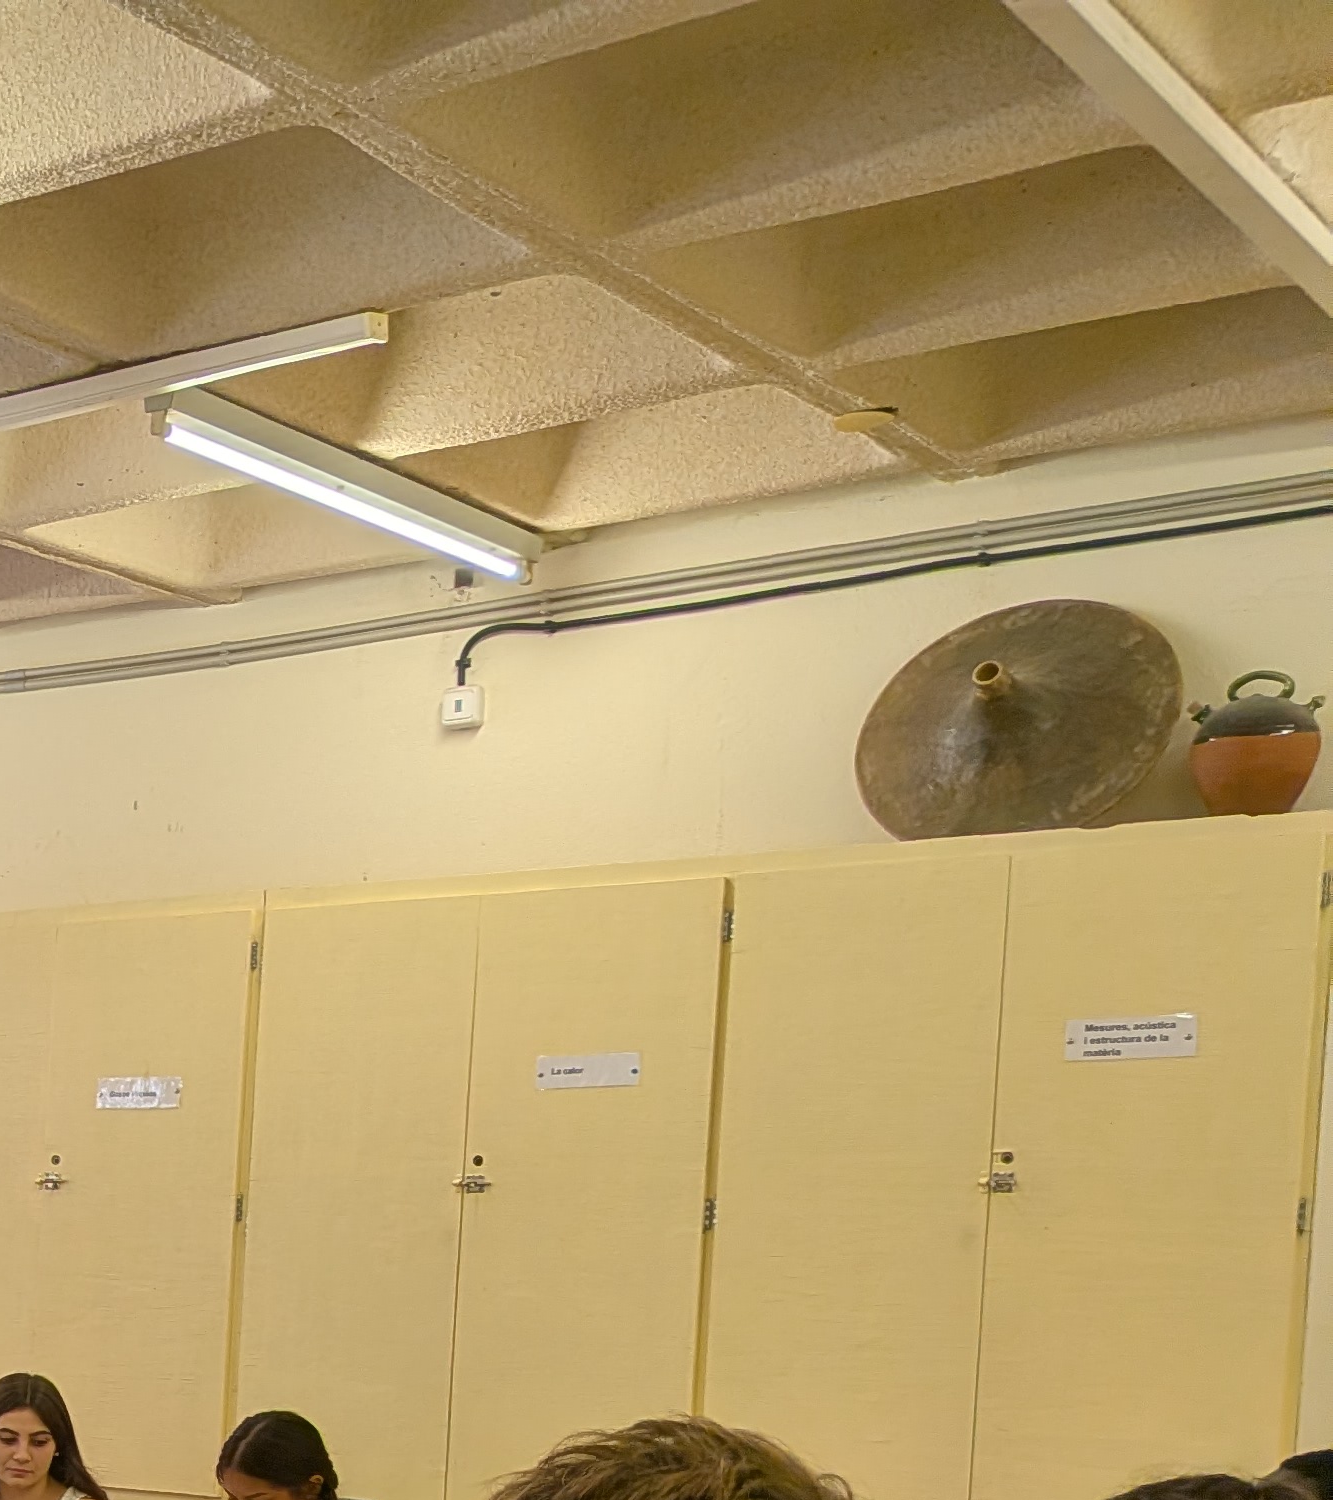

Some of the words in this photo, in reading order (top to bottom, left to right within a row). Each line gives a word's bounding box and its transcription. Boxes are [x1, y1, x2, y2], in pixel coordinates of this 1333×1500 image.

[1084, 1024, 1131, 1032] Mesures,
[1132, 1021, 1177, 1031] acústica
[1089, 1036, 1142, 1044] estructura
[1144, 1034, 1158, 1042] de
[1159, 1034, 1170, 1042] la
